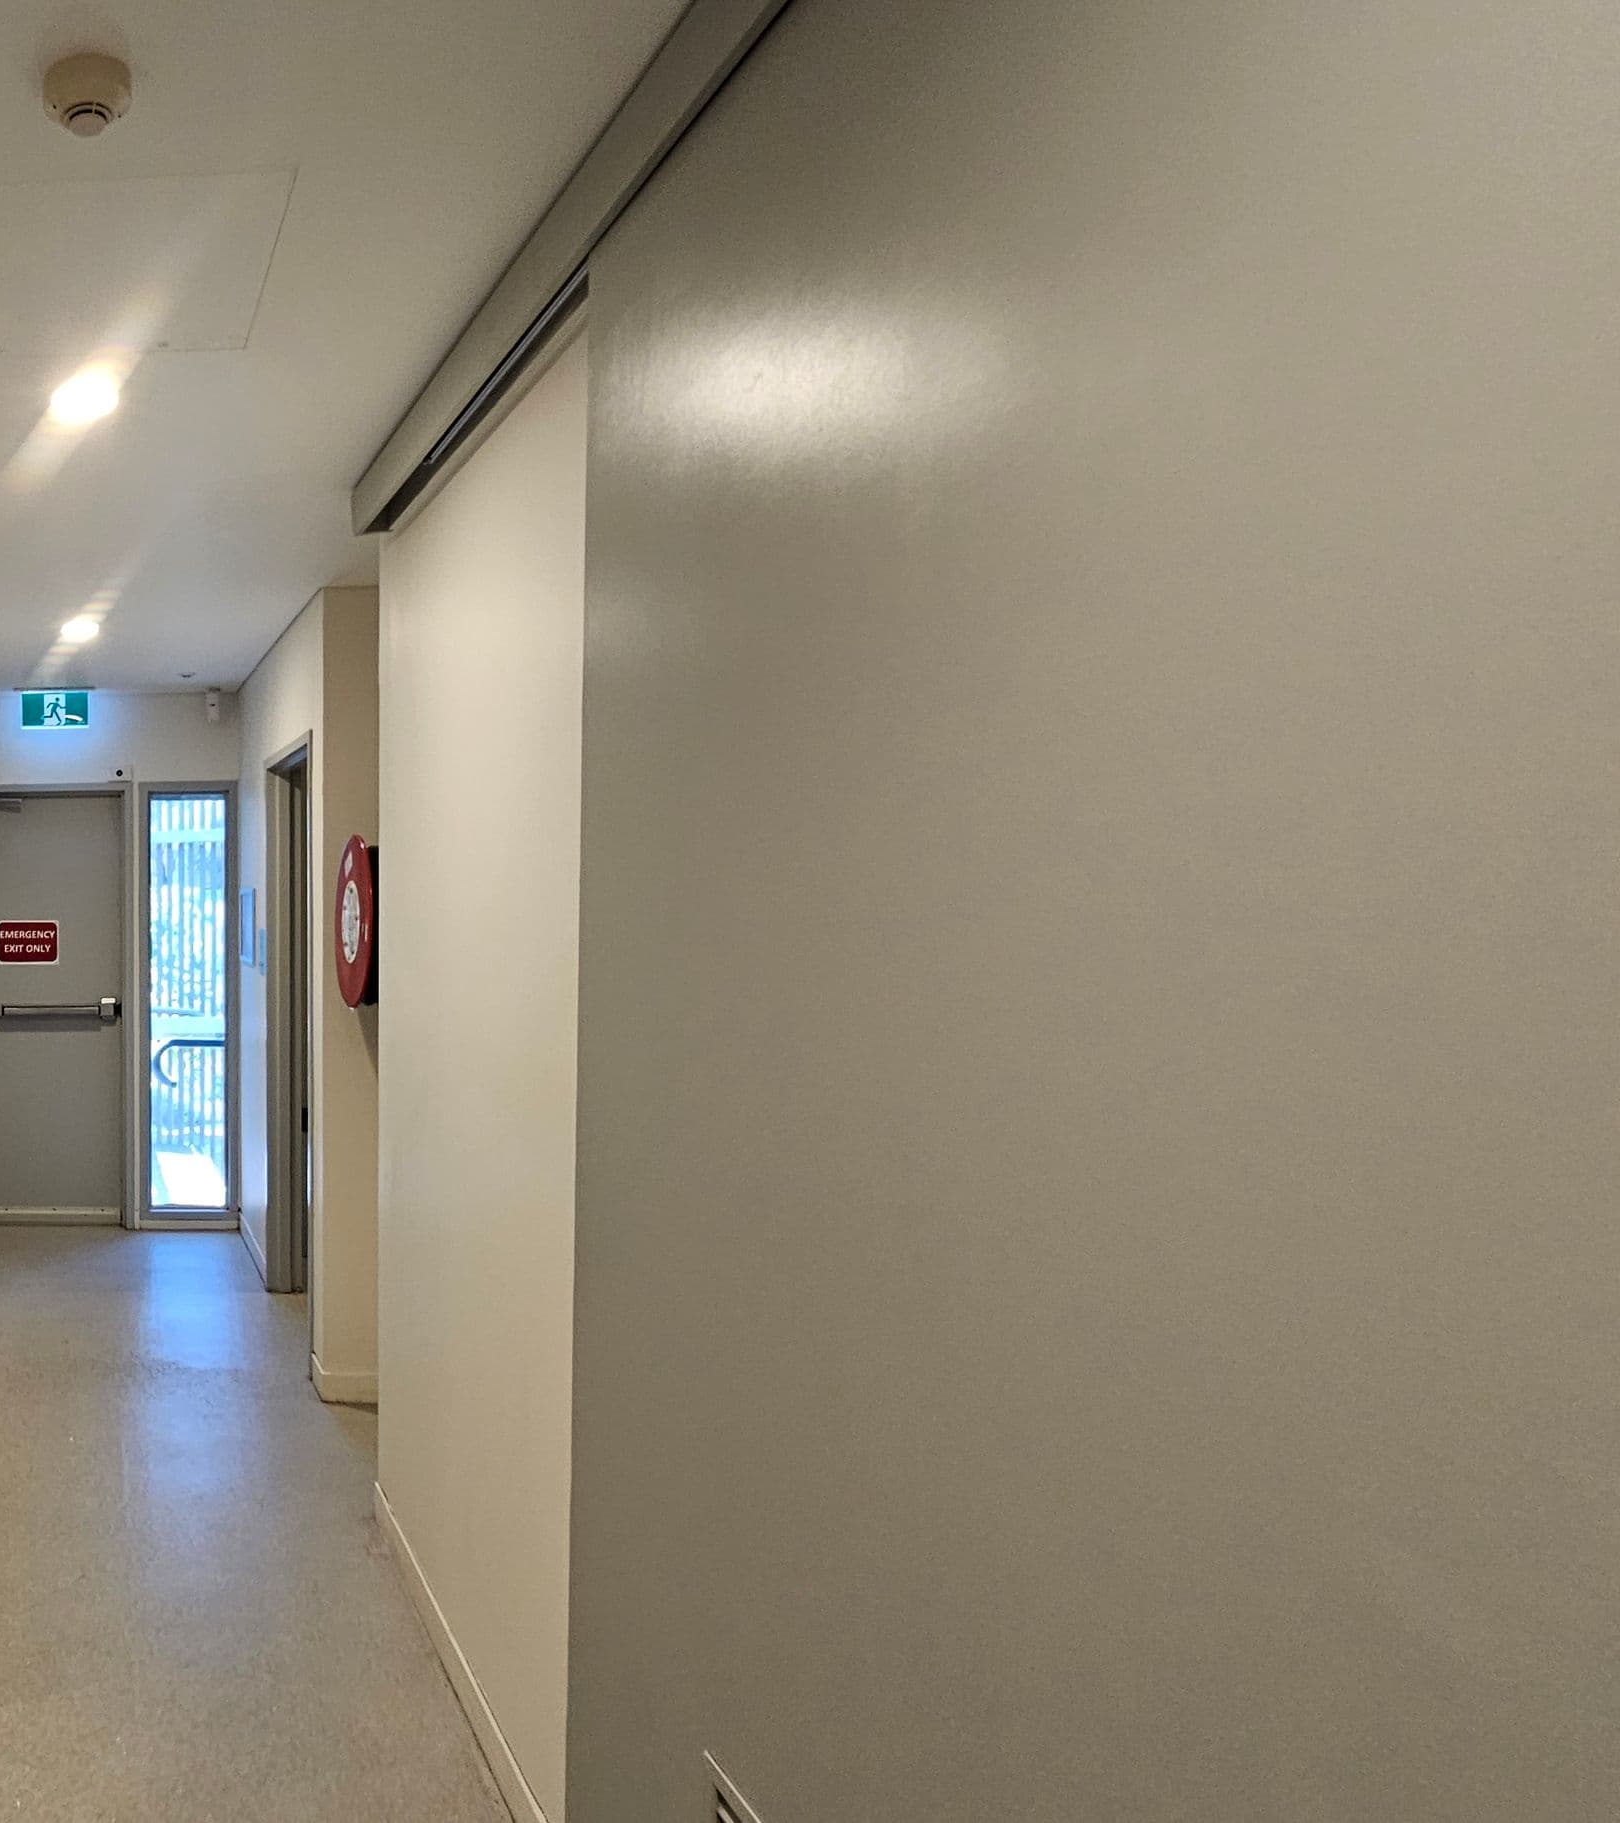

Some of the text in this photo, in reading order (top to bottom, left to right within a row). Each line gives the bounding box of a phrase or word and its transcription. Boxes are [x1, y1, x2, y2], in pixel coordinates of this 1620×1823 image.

[0, 930, 56, 939] EMERGENCY
[4, 944, 51, 953] EXIT ONLY
